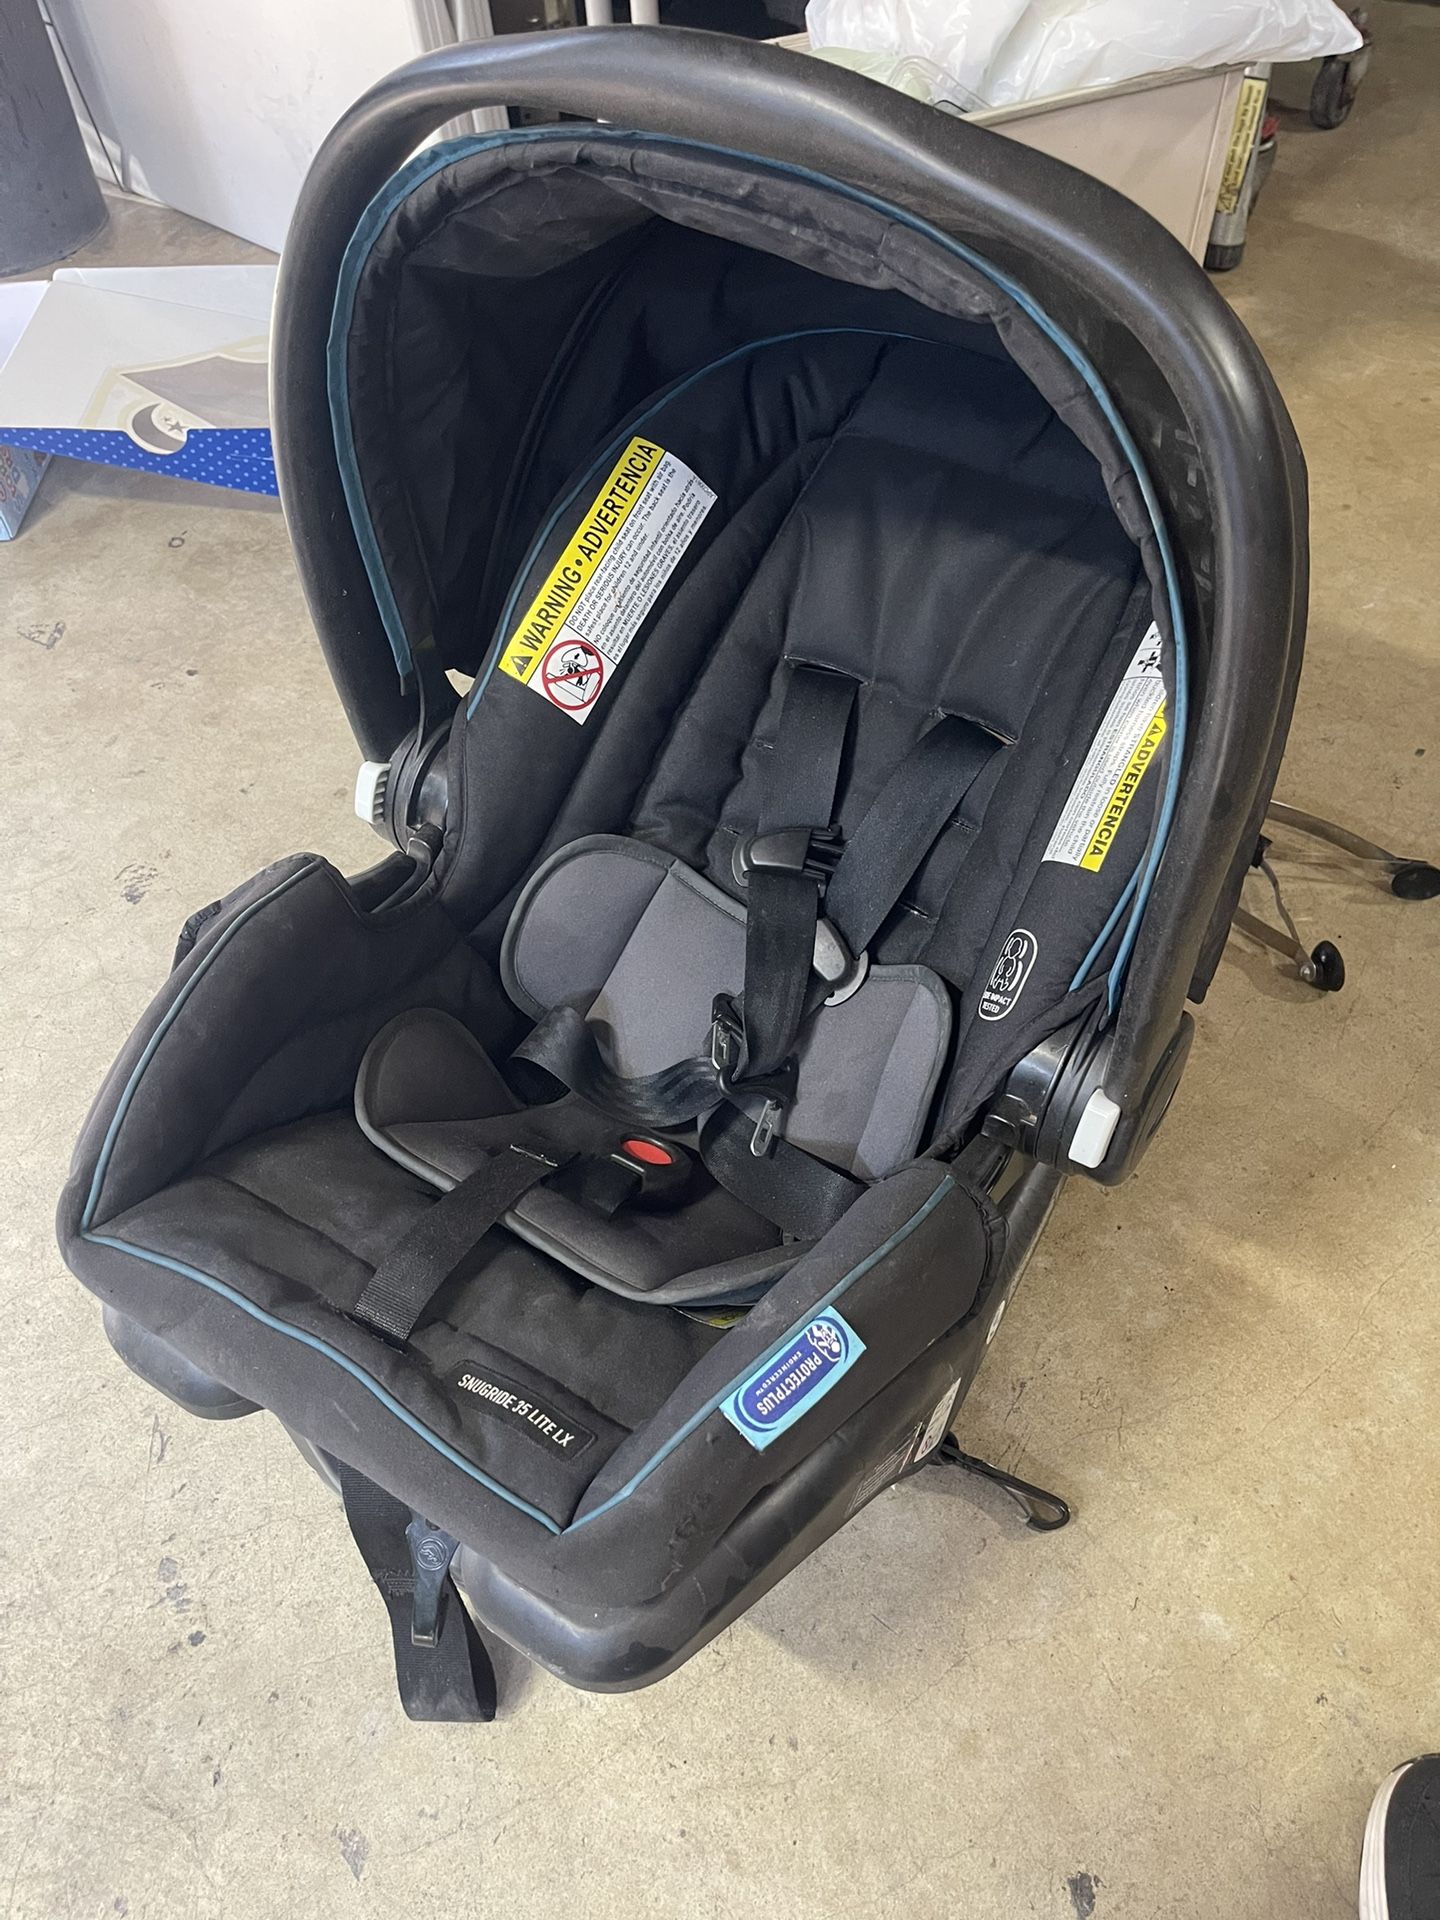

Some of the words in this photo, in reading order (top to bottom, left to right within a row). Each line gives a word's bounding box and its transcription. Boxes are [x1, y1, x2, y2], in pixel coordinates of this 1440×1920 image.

[654, 470, 664, 480] air
[659, 459, 672, 473] bag
[666, 466, 677, 478] the
[647, 478, 659, 492] with
[656, 482, 668, 497] seat
[640, 490, 652, 505] seat
[647, 495, 660, 511] back
[673, 491, 686, 508] hacia
[631, 503, 645, 519] front
[641, 509, 652, 522] The
[658, 505, 678, 533] orientado
[619, 525, 632, 540] seat
[627, 518, 636, 528] on
[520, 567, 581, 651] WARNING
[578, 445, 657, 561] ADVERTENCIA
[610, 538, 624, 555] child
[624, 538, 635, 551] can
[647, 530, 663, 551] infantil
[591, 553, 616, 587] rear-facing
[610, 549, 628, 573] INJURY
[631, 548, 653, 578] seguridad
[593, 571, 615, 601] SERIOUS
[604, 632, 622, 656] resultar
[621, 600, 639, 626] MUERTE
[638, 567, 660, 597] LESIONES
[674, 517, 690, 539] asiento
[685, 498, 701, 519] trasero
[606, 614, 623, 636] asiento
[618, 589, 638, 616] delantero
[632, 580, 643, 591] del
[654, 543, 665, 555] con
[660, 528, 673, 545] bolsa
[669, 521, 678, 530] de
[627, 576, 636, 585] de
[582, 584, 598, 603] place
[583, 617, 599, 637] safest
[593, 601, 609, 620] place
[603, 591, 613, 603] for
[608, 568, 627, 594] children
[622, 561, 632, 570] 12
[627, 549, 639, 563] and
[618, 631, 632, 648] lugar
[634, 600, 651, 622] seguro
[645, 587, 658, 603] para
[652, 578, 662, 589] los
[668, 554, 677, 563] de
[673, 546, 681, 555] 12
[574, 600, 587, 616] NOT
[588, 598, 599, 610] OR
[567, 614, 579, 626] DO
[575, 608, 593, 632] DEATH
[598, 611, 616, 636] coloque
[592, 633, 602, 644] NO
[1123, 708, 1145, 742] harness
[1079, 727, 1117, 800] ESTRANGULADO
[1108, 731, 1140, 786] STRANGLED
[1097, 768, 1113, 789] Fully
[1083, 774, 1101, 805] outside
[1090, 738, 1155, 855] ADVERTENCIA
[1082, 788, 1101, 820] restrain
[1092, 794, 1108, 819] loose
[1076, 819, 1087, 834] the
[1066, 833, 1080, 855] child
[1071, 828, 1091, 861] partially
[756, 1352, 822, 1415] PROTECTPLUS
[458, 1374, 517, 1409] SNUGRIDE
[511, 1400, 533, 1416] 35
[527, 1409, 557, 1435] LITE
[551, 1428, 575, 1447] LX
